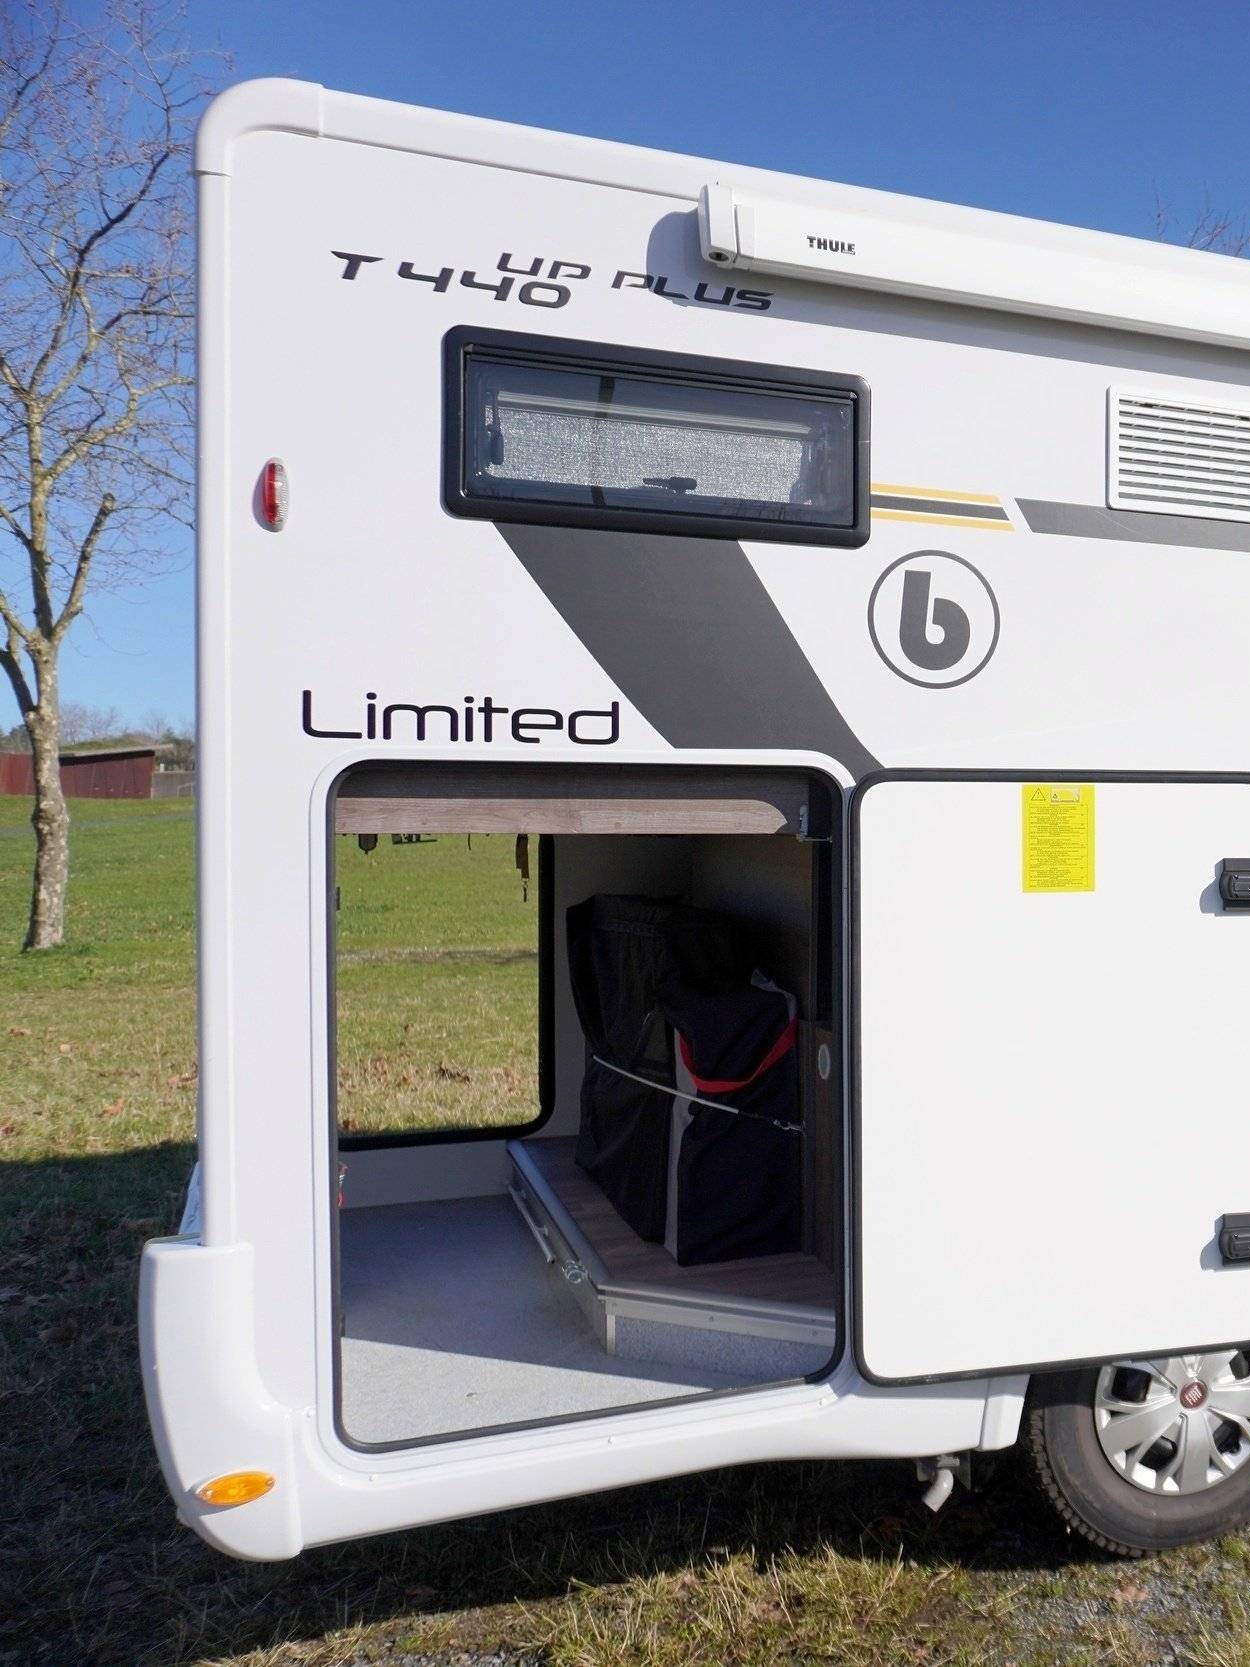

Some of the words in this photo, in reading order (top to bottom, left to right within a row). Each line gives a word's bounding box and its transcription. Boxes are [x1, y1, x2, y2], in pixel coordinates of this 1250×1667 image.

[806, 235, 855, 255] THULE
[330, 250, 384, 280] T
[397, 261, 571, 309] 440
[496, 252, 592, 280] UP
[611, 270, 775, 311] PLUS
[899, 569, 971, 671] b
[302, 689, 620, 746] Limited
[1185, 1385, 1203, 1405] FIAT
